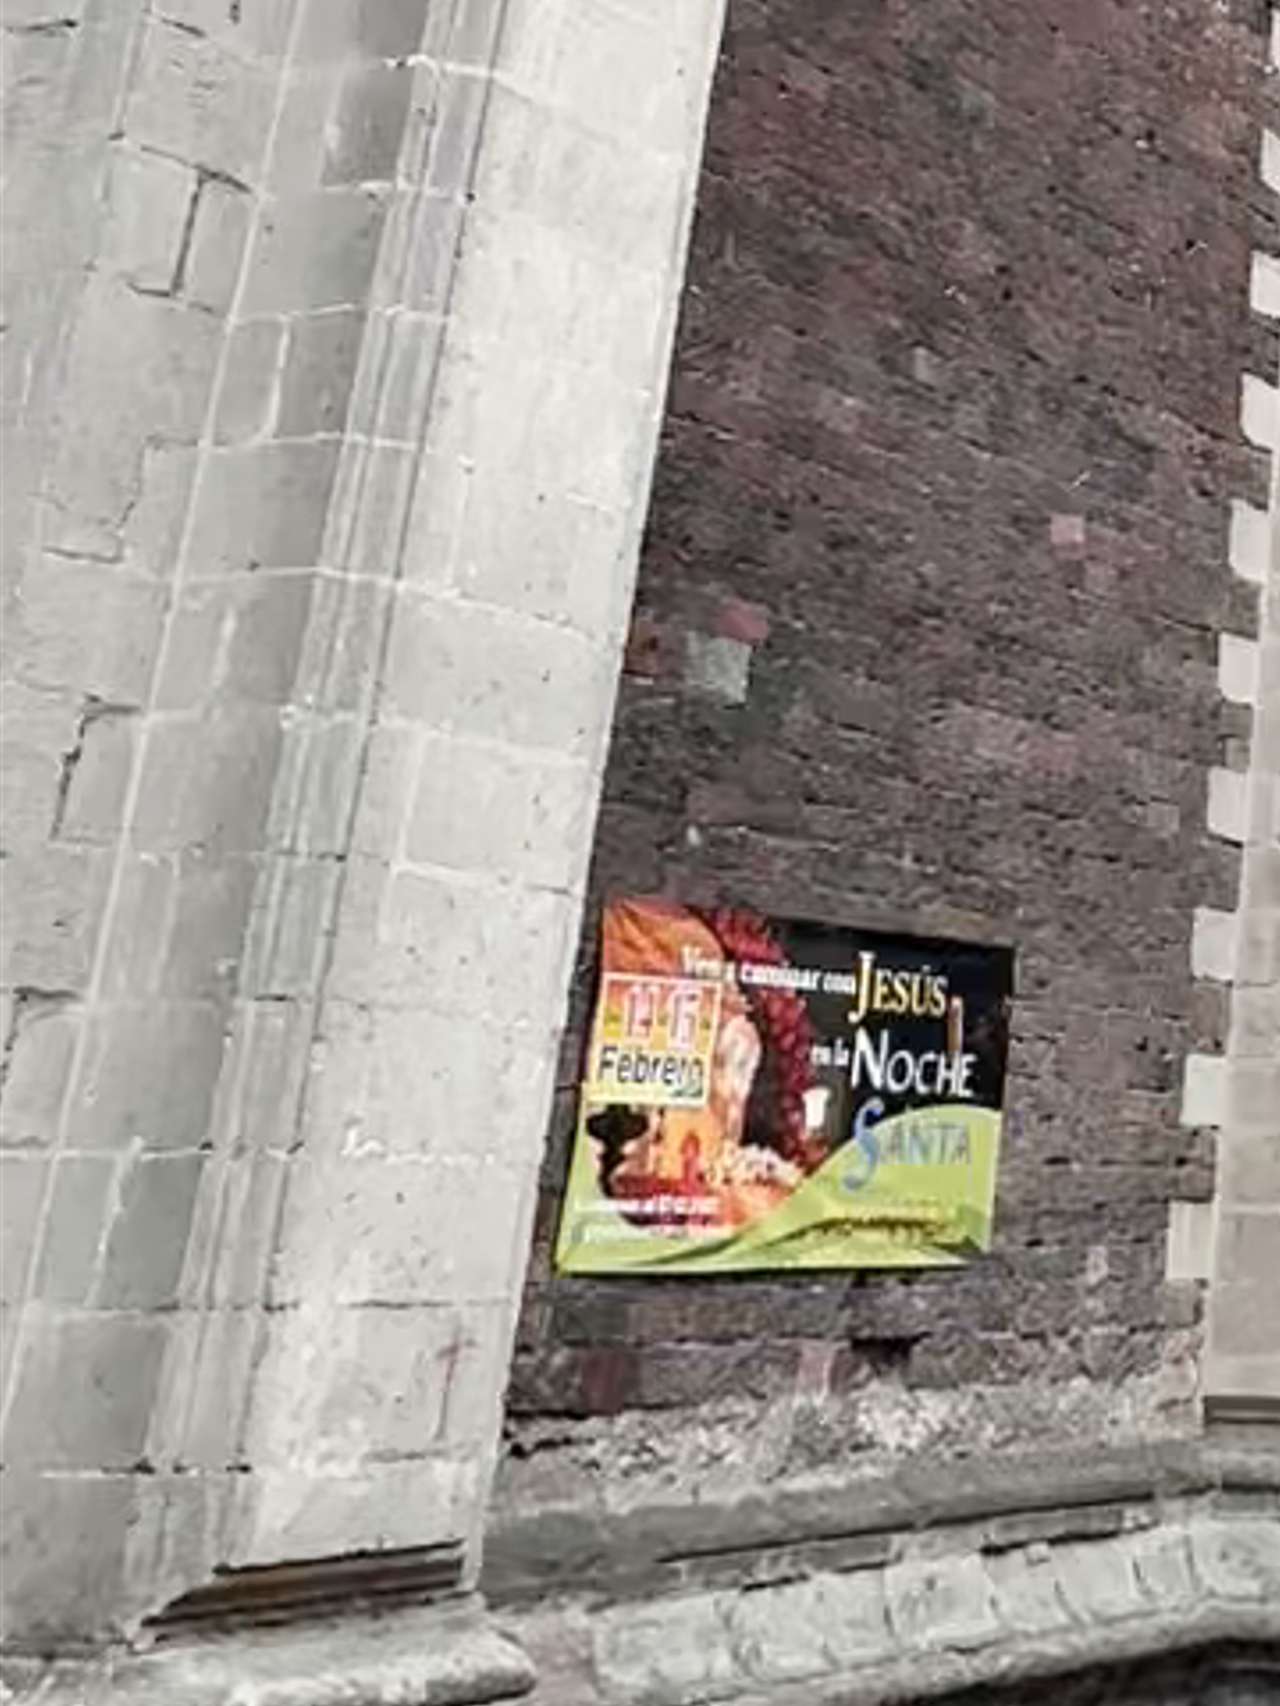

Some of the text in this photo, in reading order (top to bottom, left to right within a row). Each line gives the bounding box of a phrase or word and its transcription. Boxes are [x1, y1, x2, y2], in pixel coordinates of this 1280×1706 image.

[848, 950, 948, 1024] JESÚS
[598, 1044, 704, 1086] Febrero
[852, 1026, 978, 1099] NOCHE
[842, 1098, 972, 1193] SANTA
